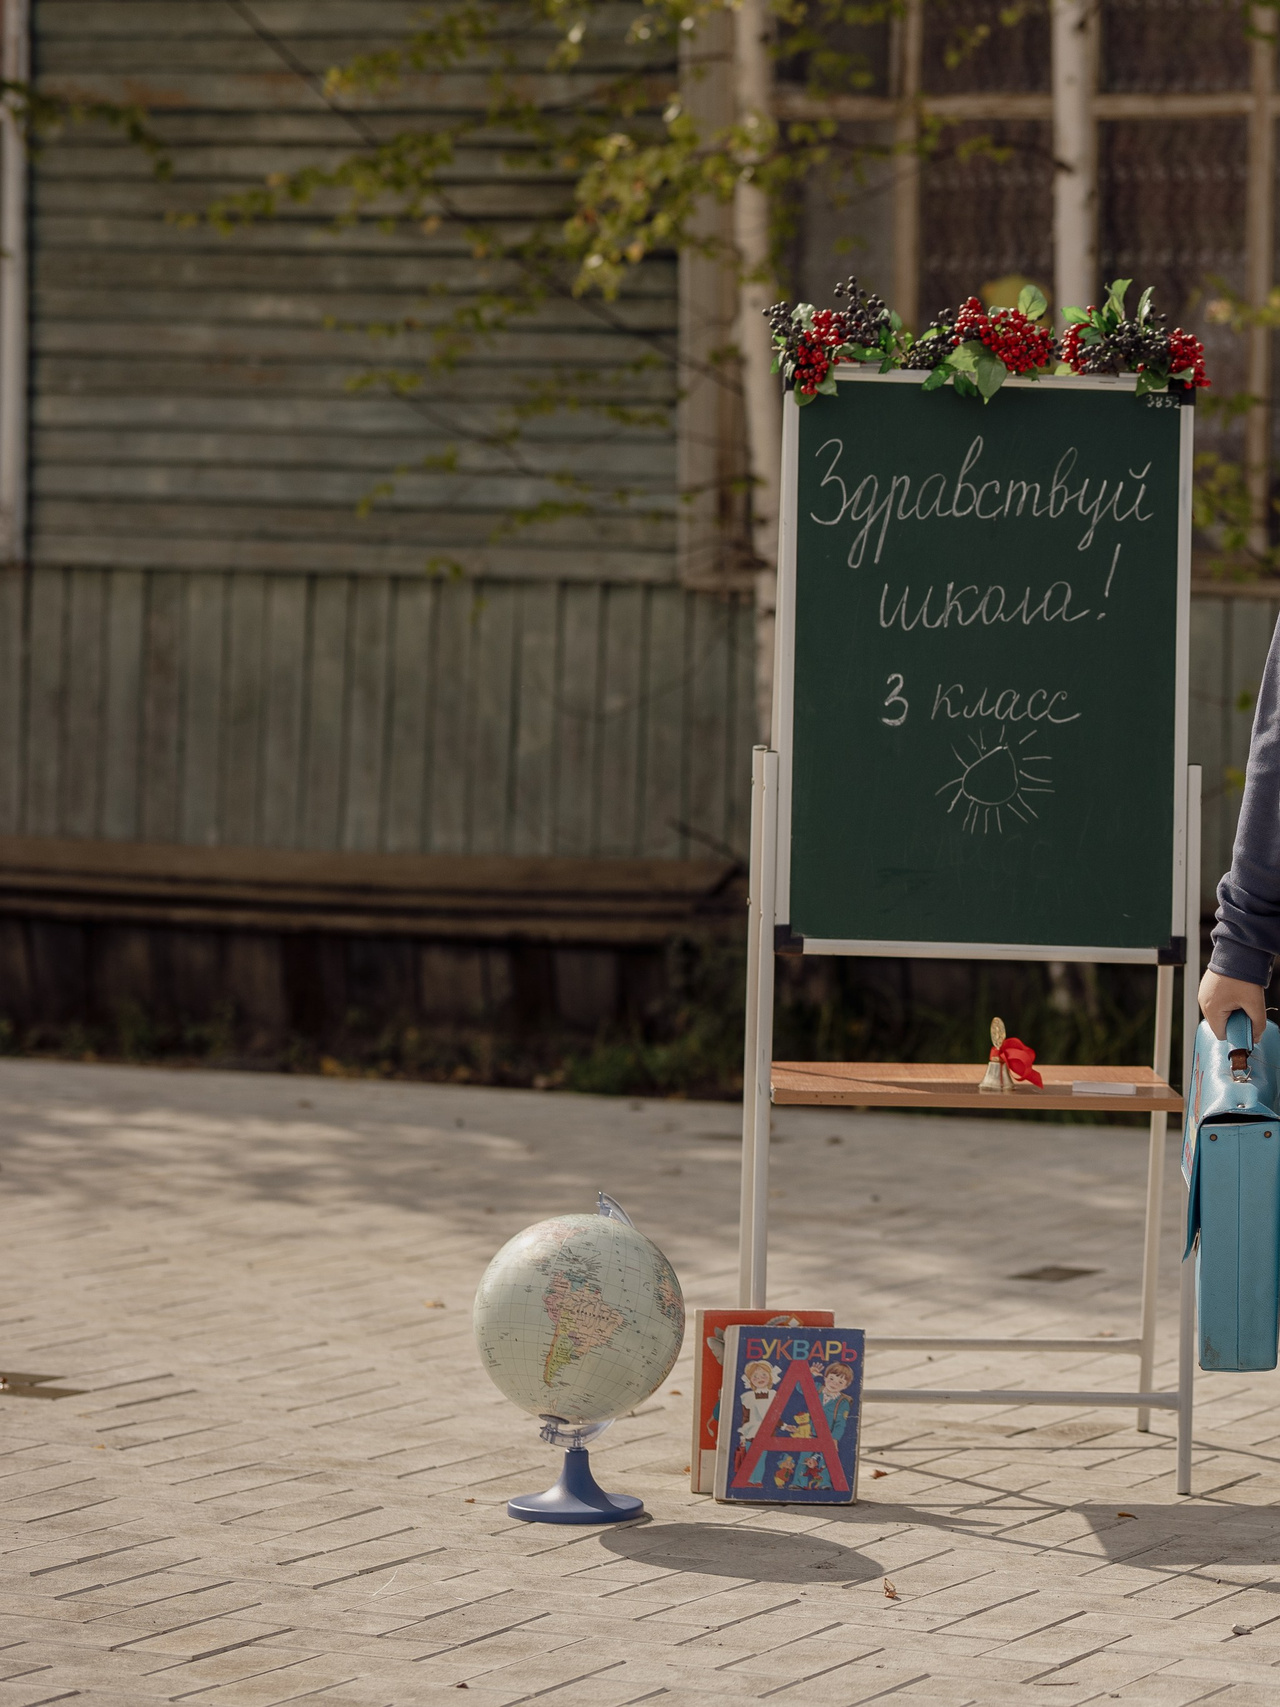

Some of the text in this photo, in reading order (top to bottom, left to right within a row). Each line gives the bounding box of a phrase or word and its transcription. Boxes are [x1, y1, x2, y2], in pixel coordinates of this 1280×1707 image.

[810, 435, 1154, 568] Здравствуй
[881, 673, 1082, 726] 3 класс
[746, 1338, 858, 1362] БУКВАРЬ
